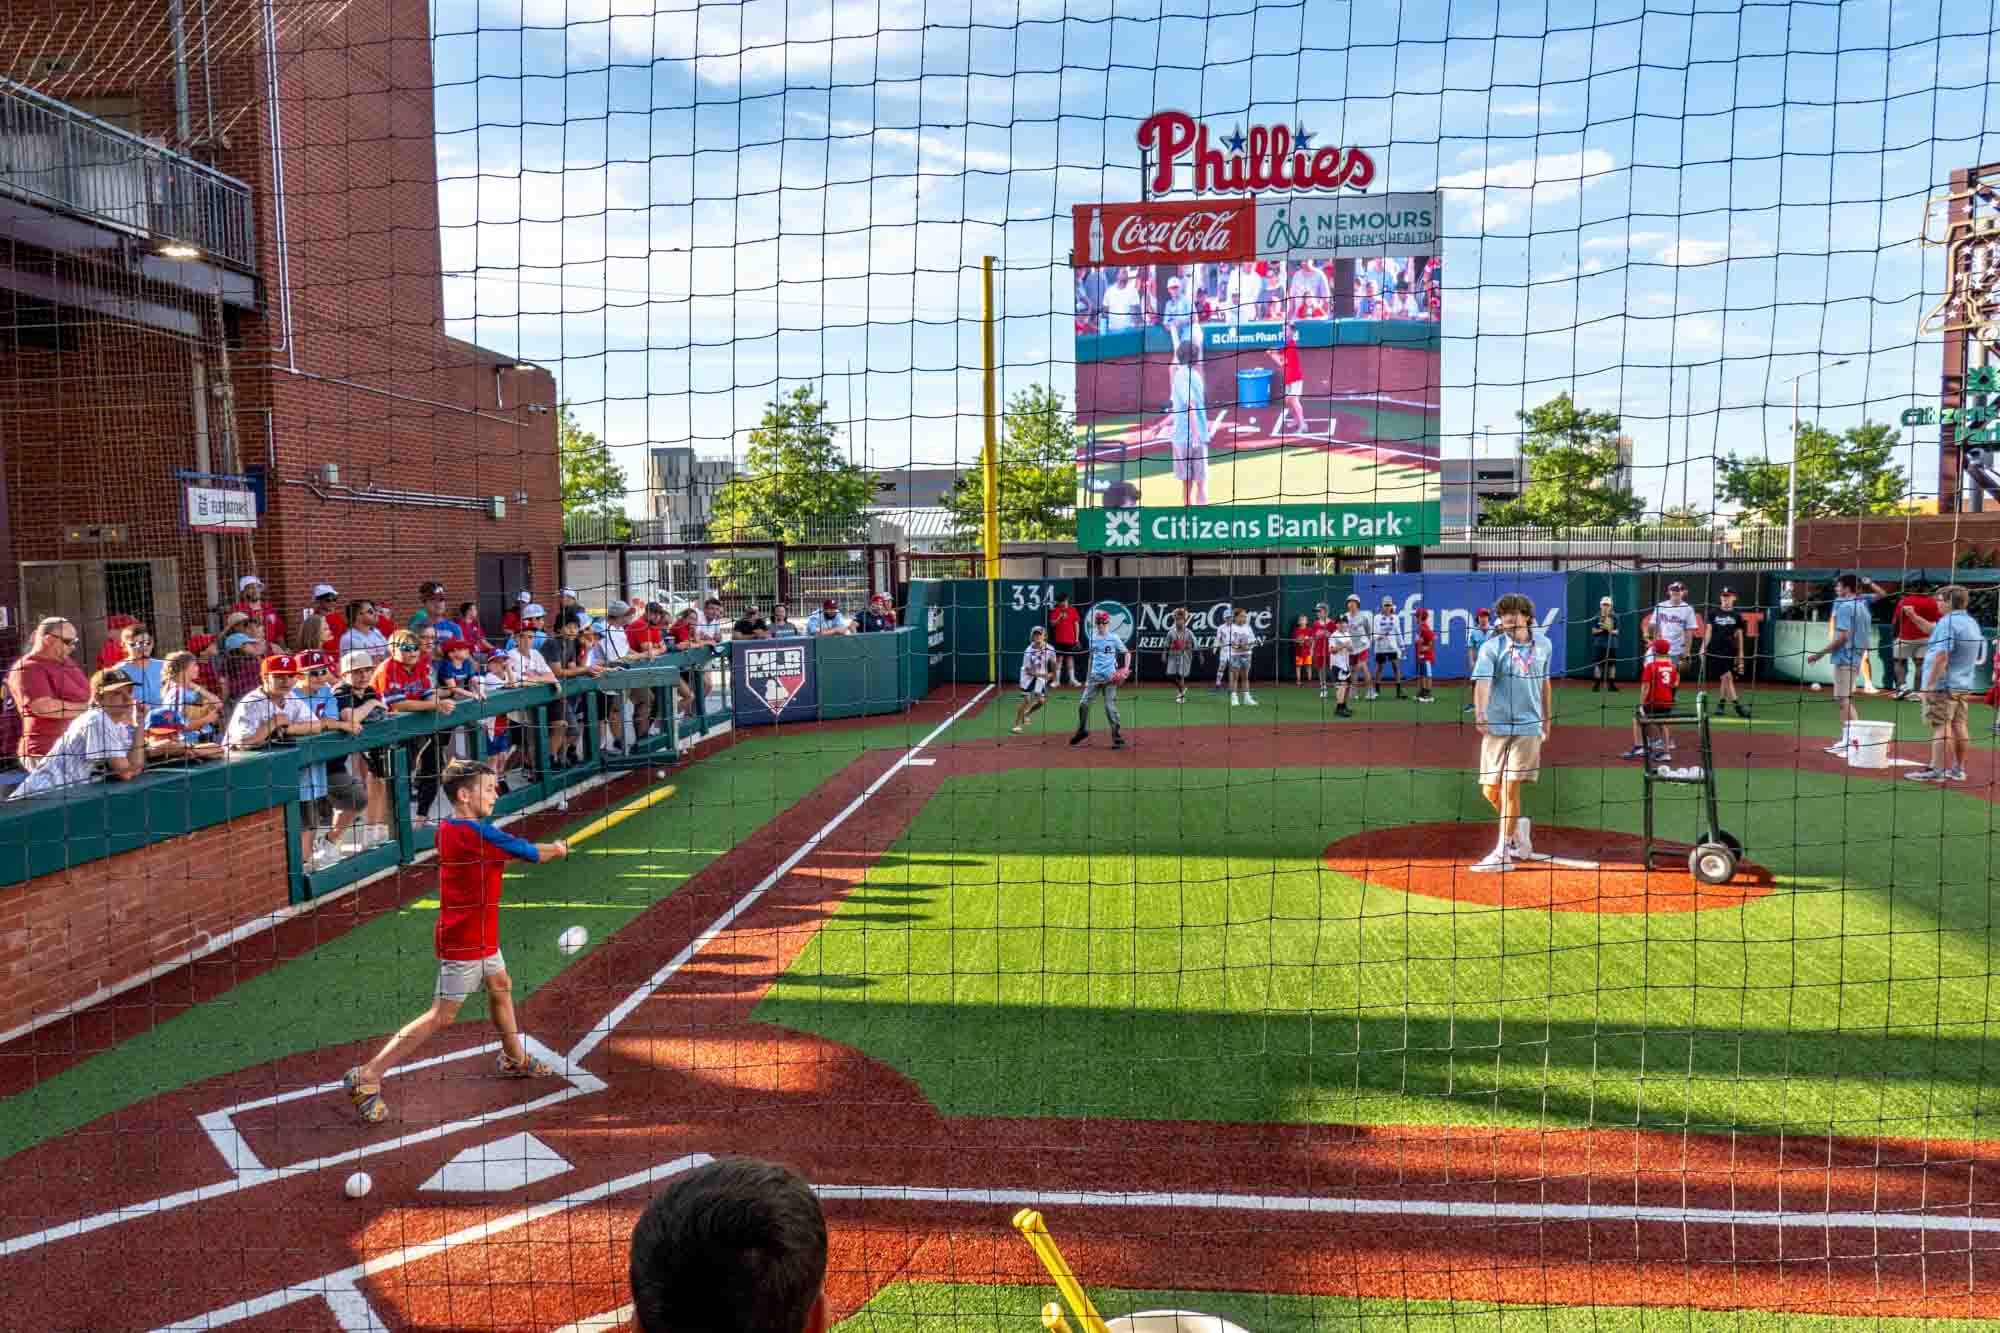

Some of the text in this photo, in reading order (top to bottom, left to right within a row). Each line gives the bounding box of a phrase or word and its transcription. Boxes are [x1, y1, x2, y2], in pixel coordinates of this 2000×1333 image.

[1138, 111, 1374, 195] Phillies
[1112, 210, 1240, 254] Coca-Cola
[1317, 210, 1432, 230] NEMOURS
[1388, 230, 1432, 243] HEALTH
[1151, 513, 1261, 541] Citizens
[1267, 513, 1335, 538] Bank
[1011, 585, 1055, 612] 334
[749, 650, 801, 671] MLB
[1661, 671, 1670, 685] 3
